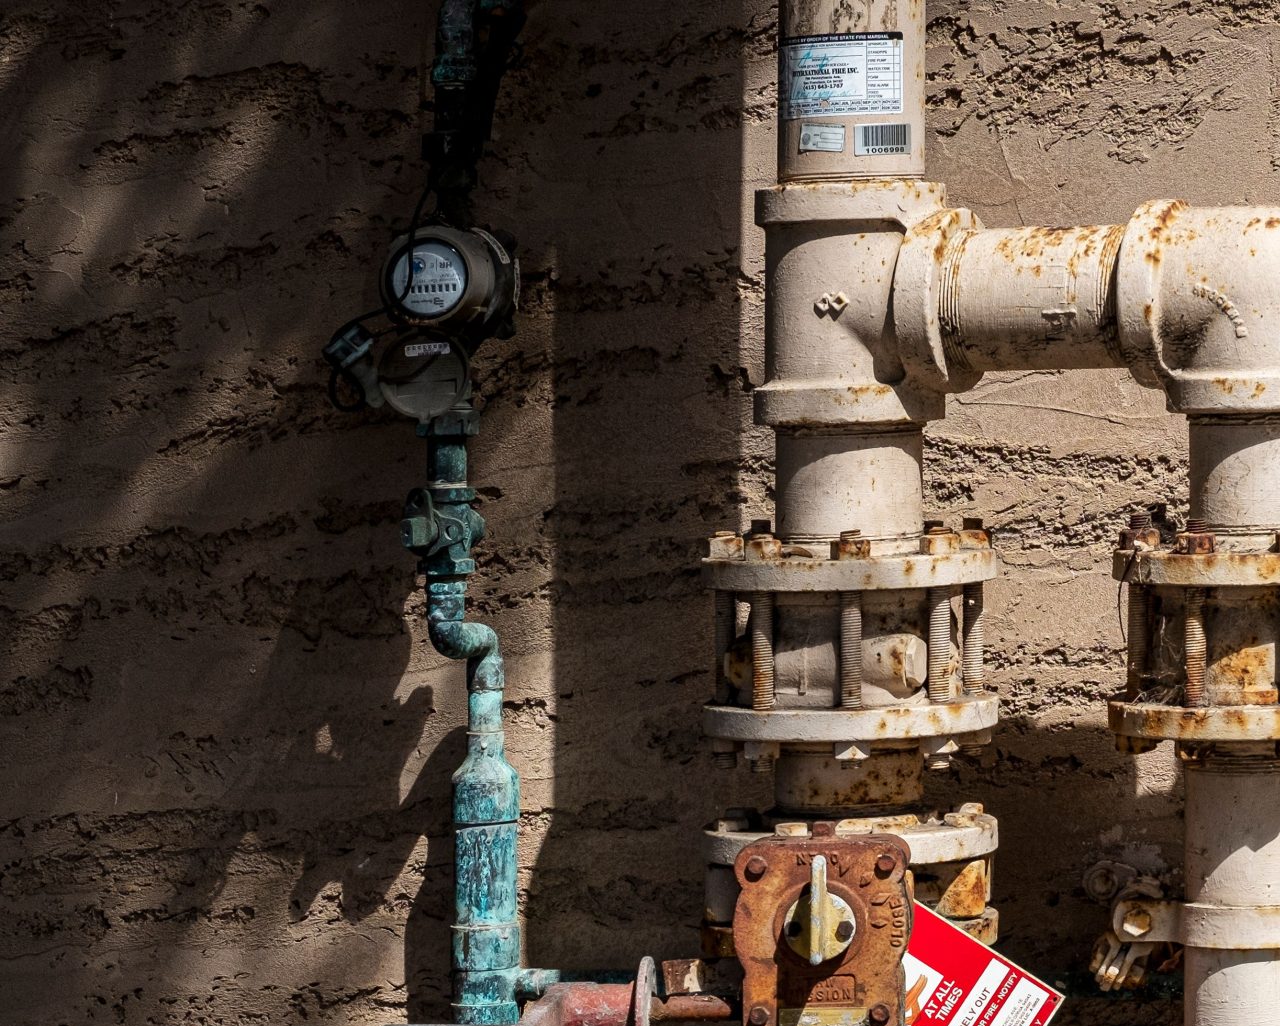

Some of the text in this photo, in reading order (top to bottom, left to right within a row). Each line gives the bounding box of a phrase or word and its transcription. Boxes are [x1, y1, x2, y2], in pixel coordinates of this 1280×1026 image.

[923, 976, 955, 1018] AT ALL
[934, 985, 963, 1023] TIMES
[974, 986, 991, 1008] OUT
[983, 1002, 998, 1020] FIRE
[997, 972, 1018, 1000] NOTIFY
